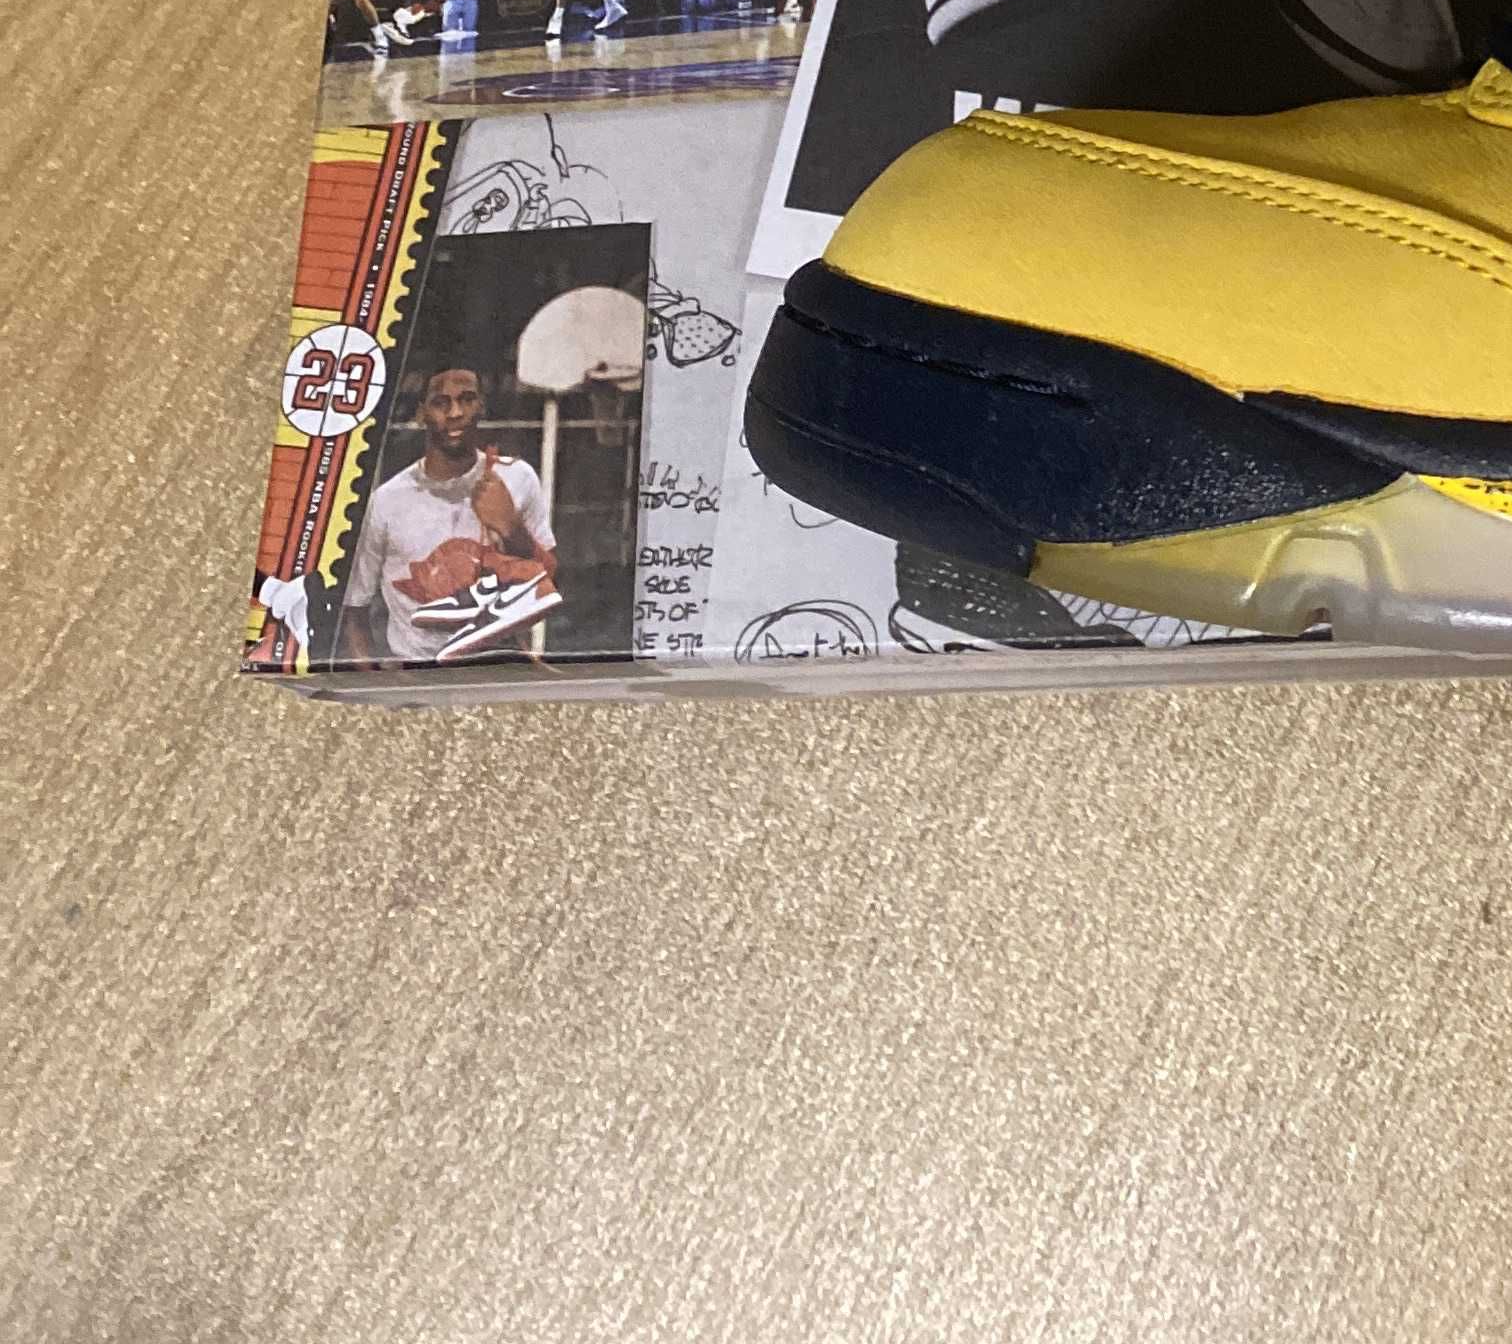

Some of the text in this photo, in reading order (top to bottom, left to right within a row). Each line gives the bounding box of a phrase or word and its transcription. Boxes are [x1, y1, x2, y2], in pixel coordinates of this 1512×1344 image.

[383, 169, 405, 214] DRAFT
[375, 219, 392, 251] PICK
[292, 348, 376, 415] 23
[318, 441, 335, 475] 1985
[309, 481, 325, 515] NBA
[293, 520, 315, 577] ROOKIE
